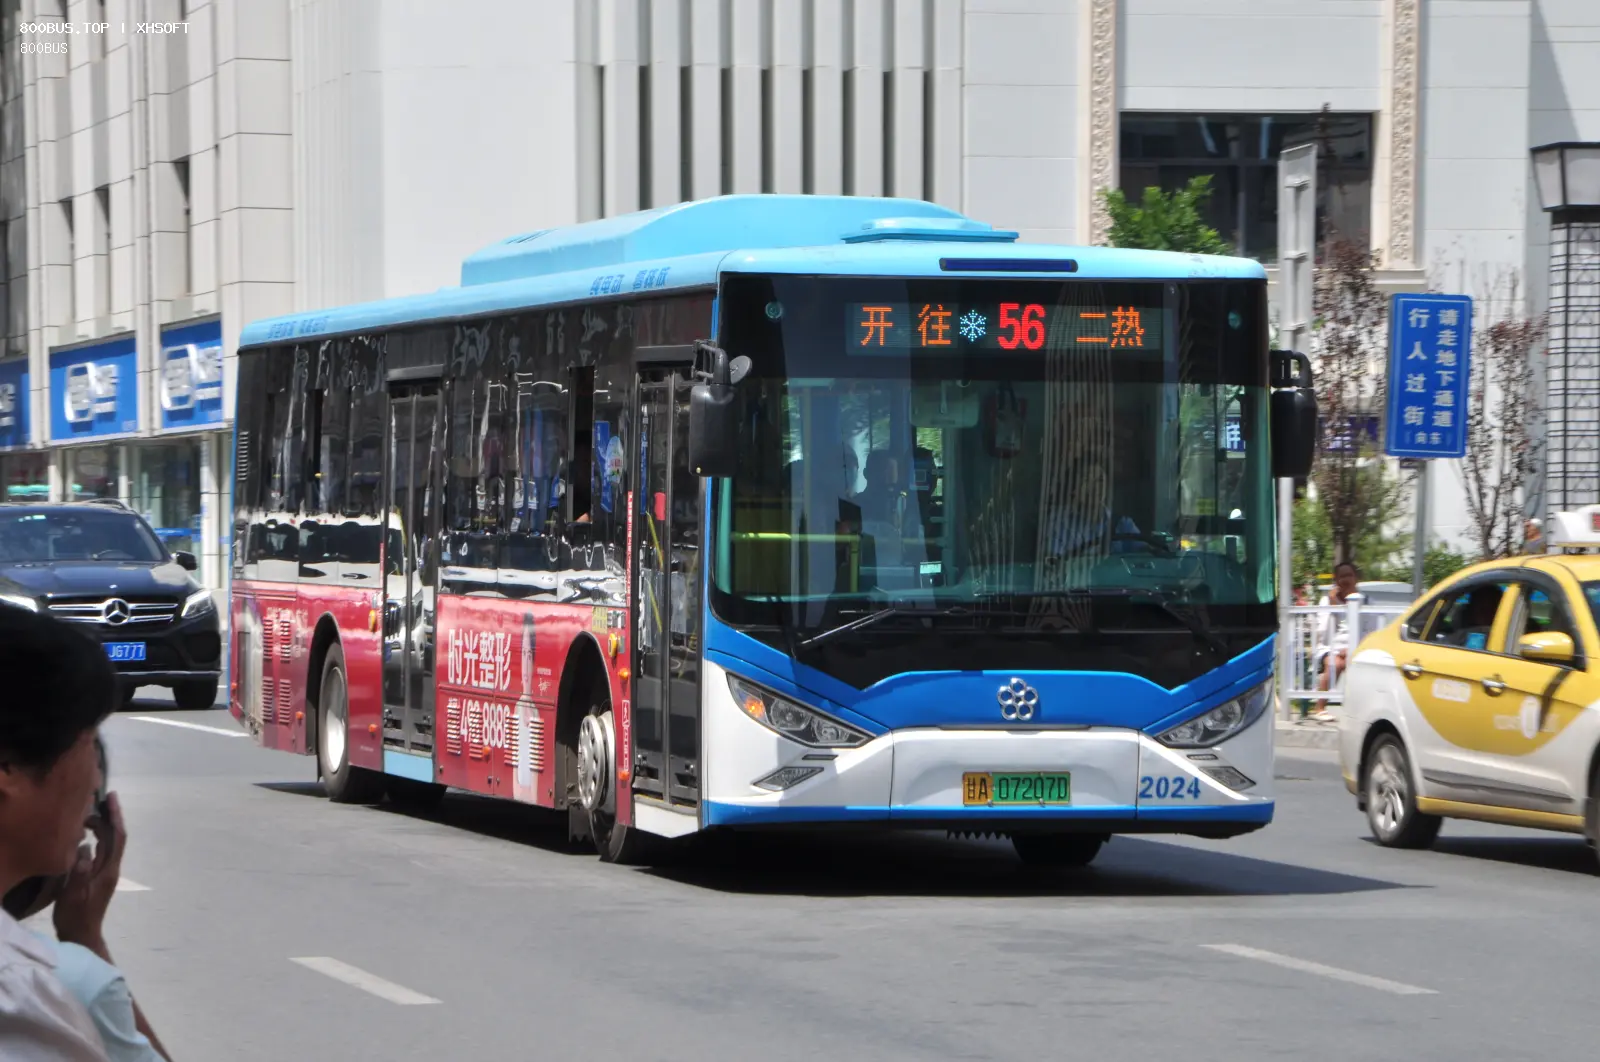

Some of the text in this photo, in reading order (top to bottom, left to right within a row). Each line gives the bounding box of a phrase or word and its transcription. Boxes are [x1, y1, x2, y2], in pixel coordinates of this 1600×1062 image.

[998, 303, 1045, 349] 56
[1076, 306, 1145, 347] 二热
[1403, 308, 1430, 426] 行人过街
[1432, 309, 1460, 427] 请走地下通道
[448, 628, 511, 691] 时光整形
[1138, 776, 1200, 799] 2024
